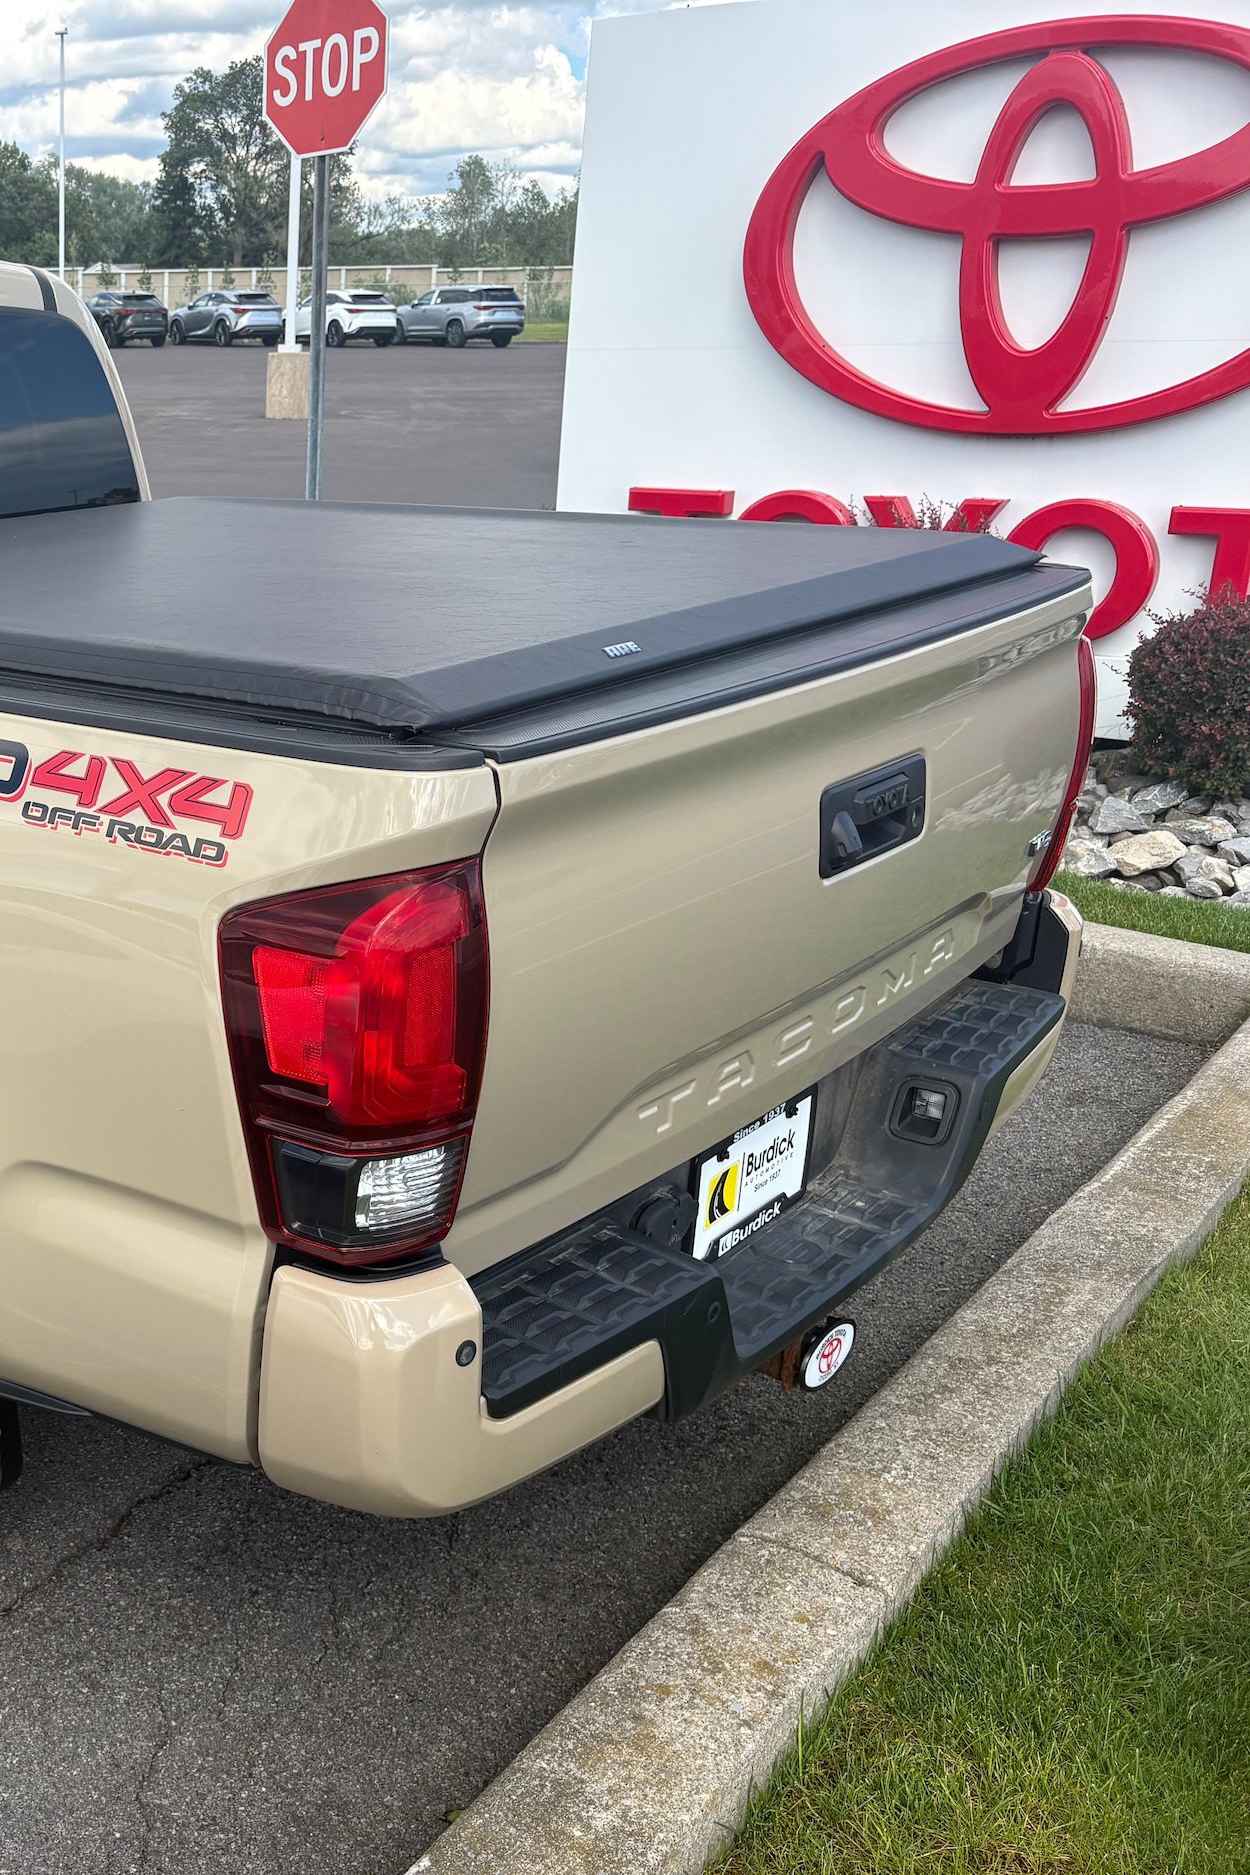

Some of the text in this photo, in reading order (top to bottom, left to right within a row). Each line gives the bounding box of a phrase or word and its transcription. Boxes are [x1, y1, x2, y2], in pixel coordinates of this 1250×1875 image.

[273, 27, 380, 107] STOP
[21, 801, 229, 868] OFF ROAD
[636, 928, 955, 1133] TACOMA
[733, 1103, 787, 1143] Since 1937
[744, 1151, 794, 1188] AUTOMOTIVE
[745, 1128, 796, 1177] Burdick
[753, 1178, 769, 1193] Since
[731, 1200, 782, 1248] Burdick
